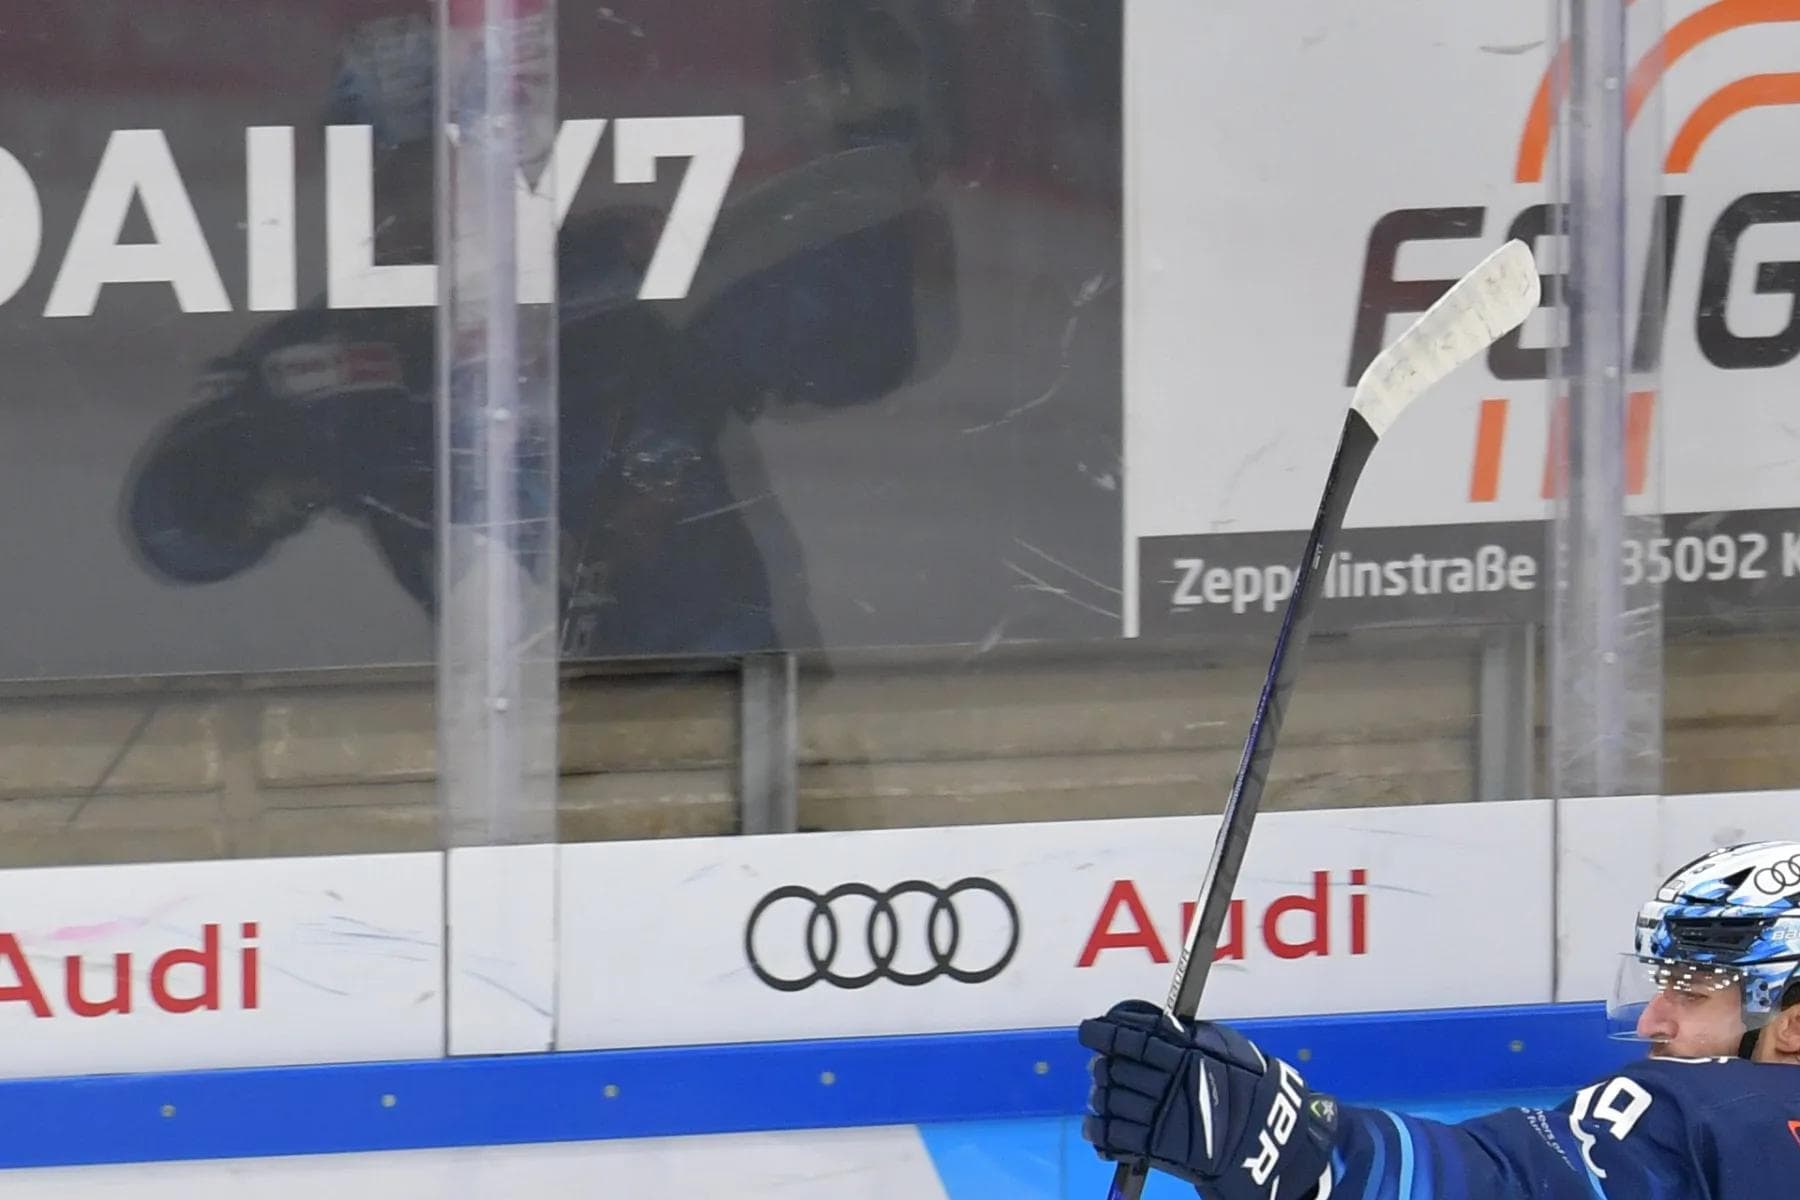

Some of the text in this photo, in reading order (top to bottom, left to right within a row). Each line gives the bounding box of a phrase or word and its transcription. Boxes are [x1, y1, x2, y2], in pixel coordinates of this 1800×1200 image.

[0, 115, 744, 317] AILY7
[1173, 545, 1537, 613] Zepplinstraße
[1075, 869, 1368, 967] Audi
